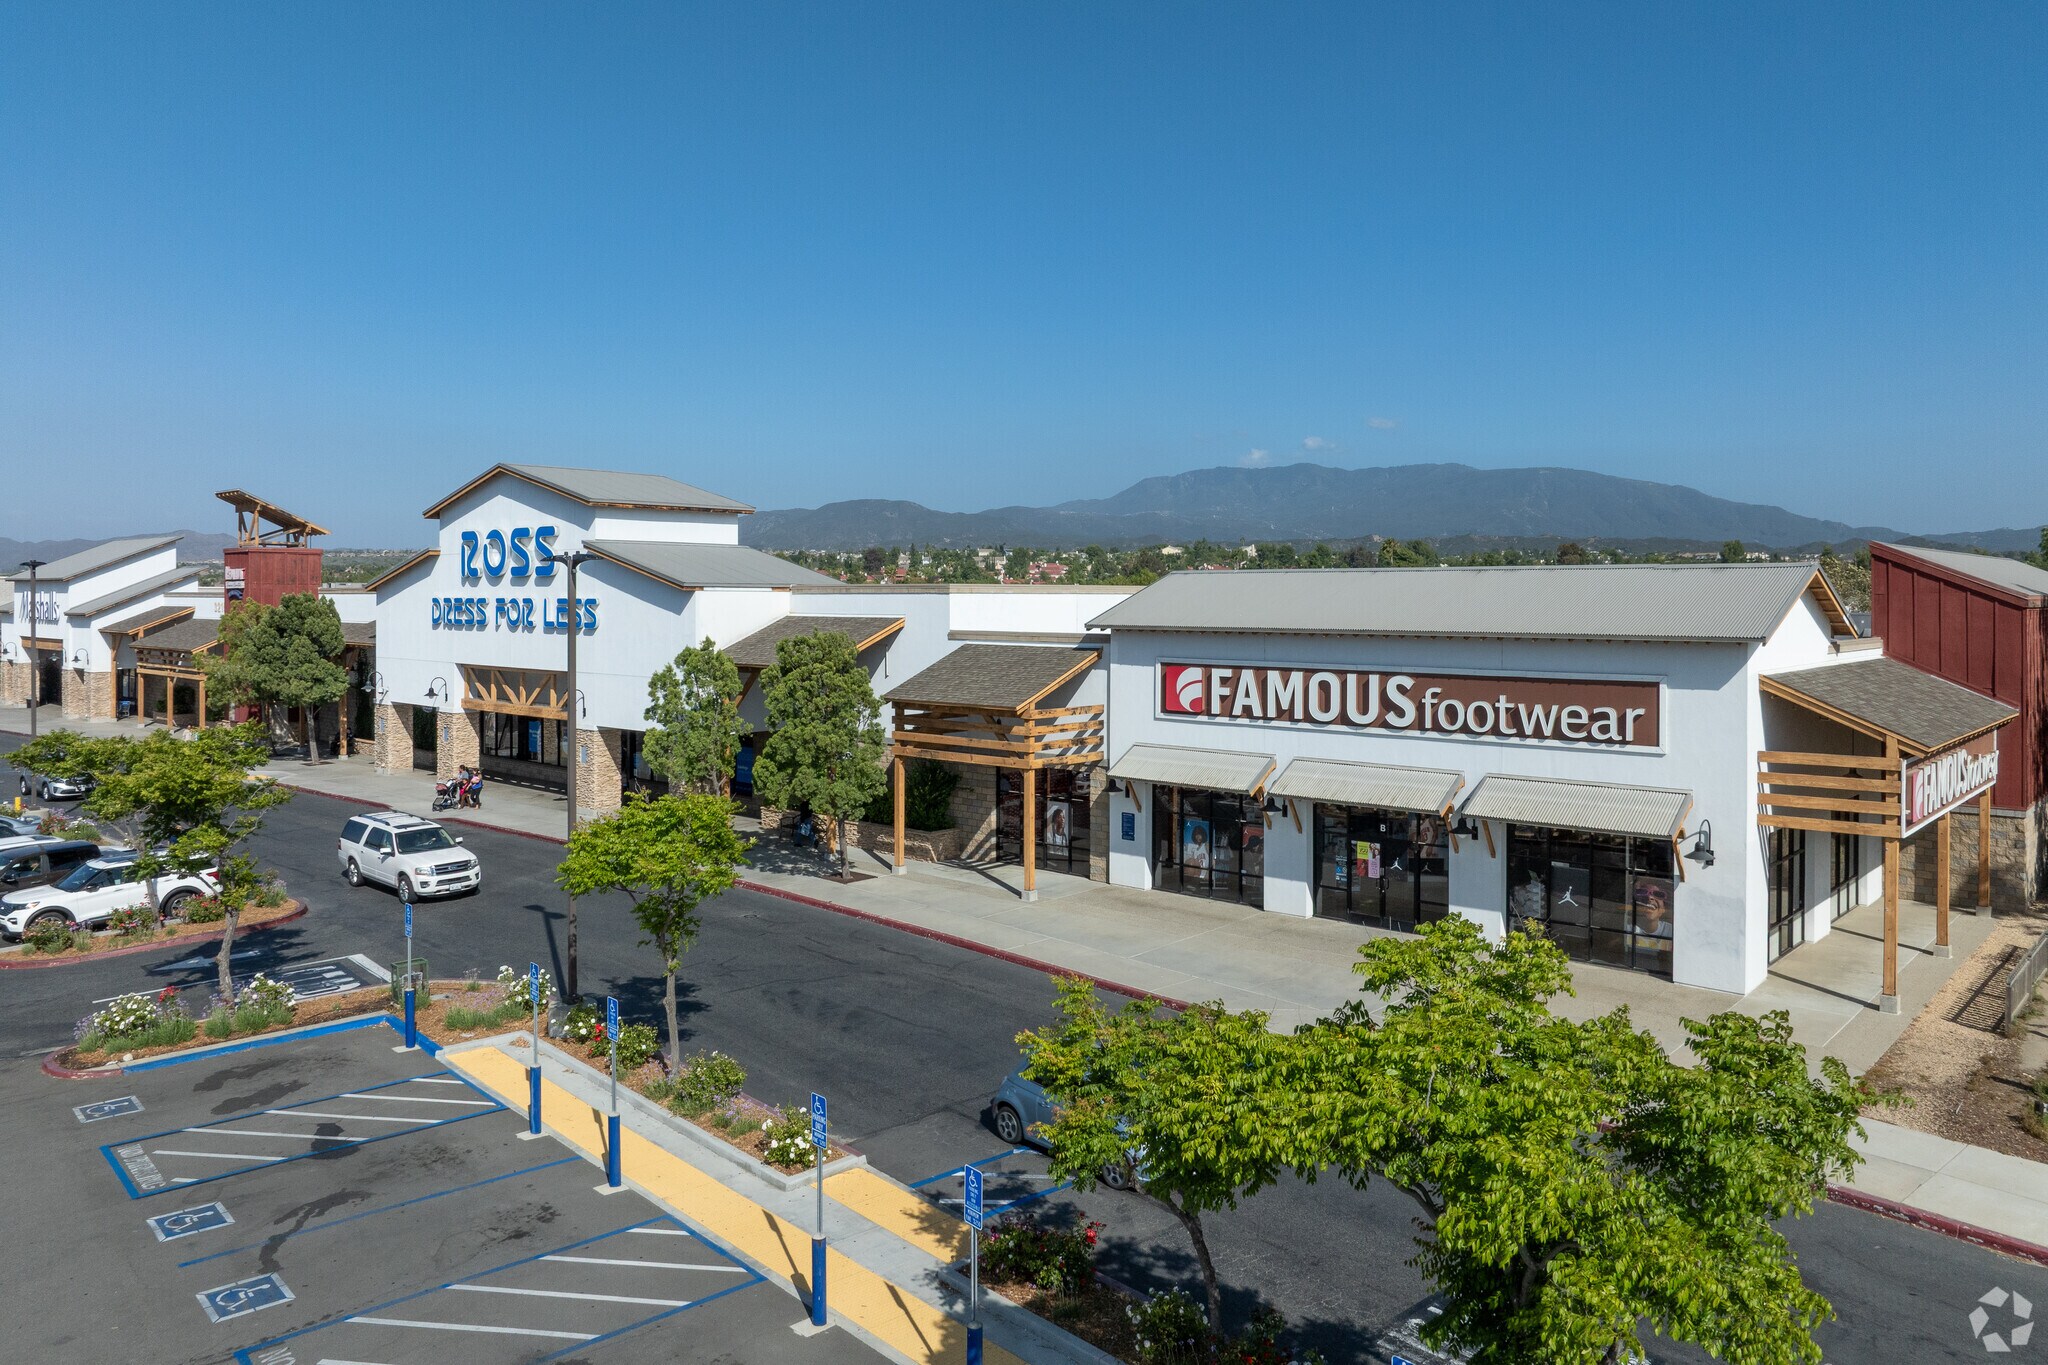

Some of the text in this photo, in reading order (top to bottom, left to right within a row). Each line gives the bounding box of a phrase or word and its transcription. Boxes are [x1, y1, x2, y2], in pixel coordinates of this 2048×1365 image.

[461, 526, 558, 577] ROSS
[19, 591, 59, 620] Mashalls
[432, 597, 600, 629] DRESS FOR LESS
[1211, 668, 1646, 742] FAMOUS footwear
[1923, 749, 1967, 816] FAMOUS
[1380, 824, 1386, 832] B
